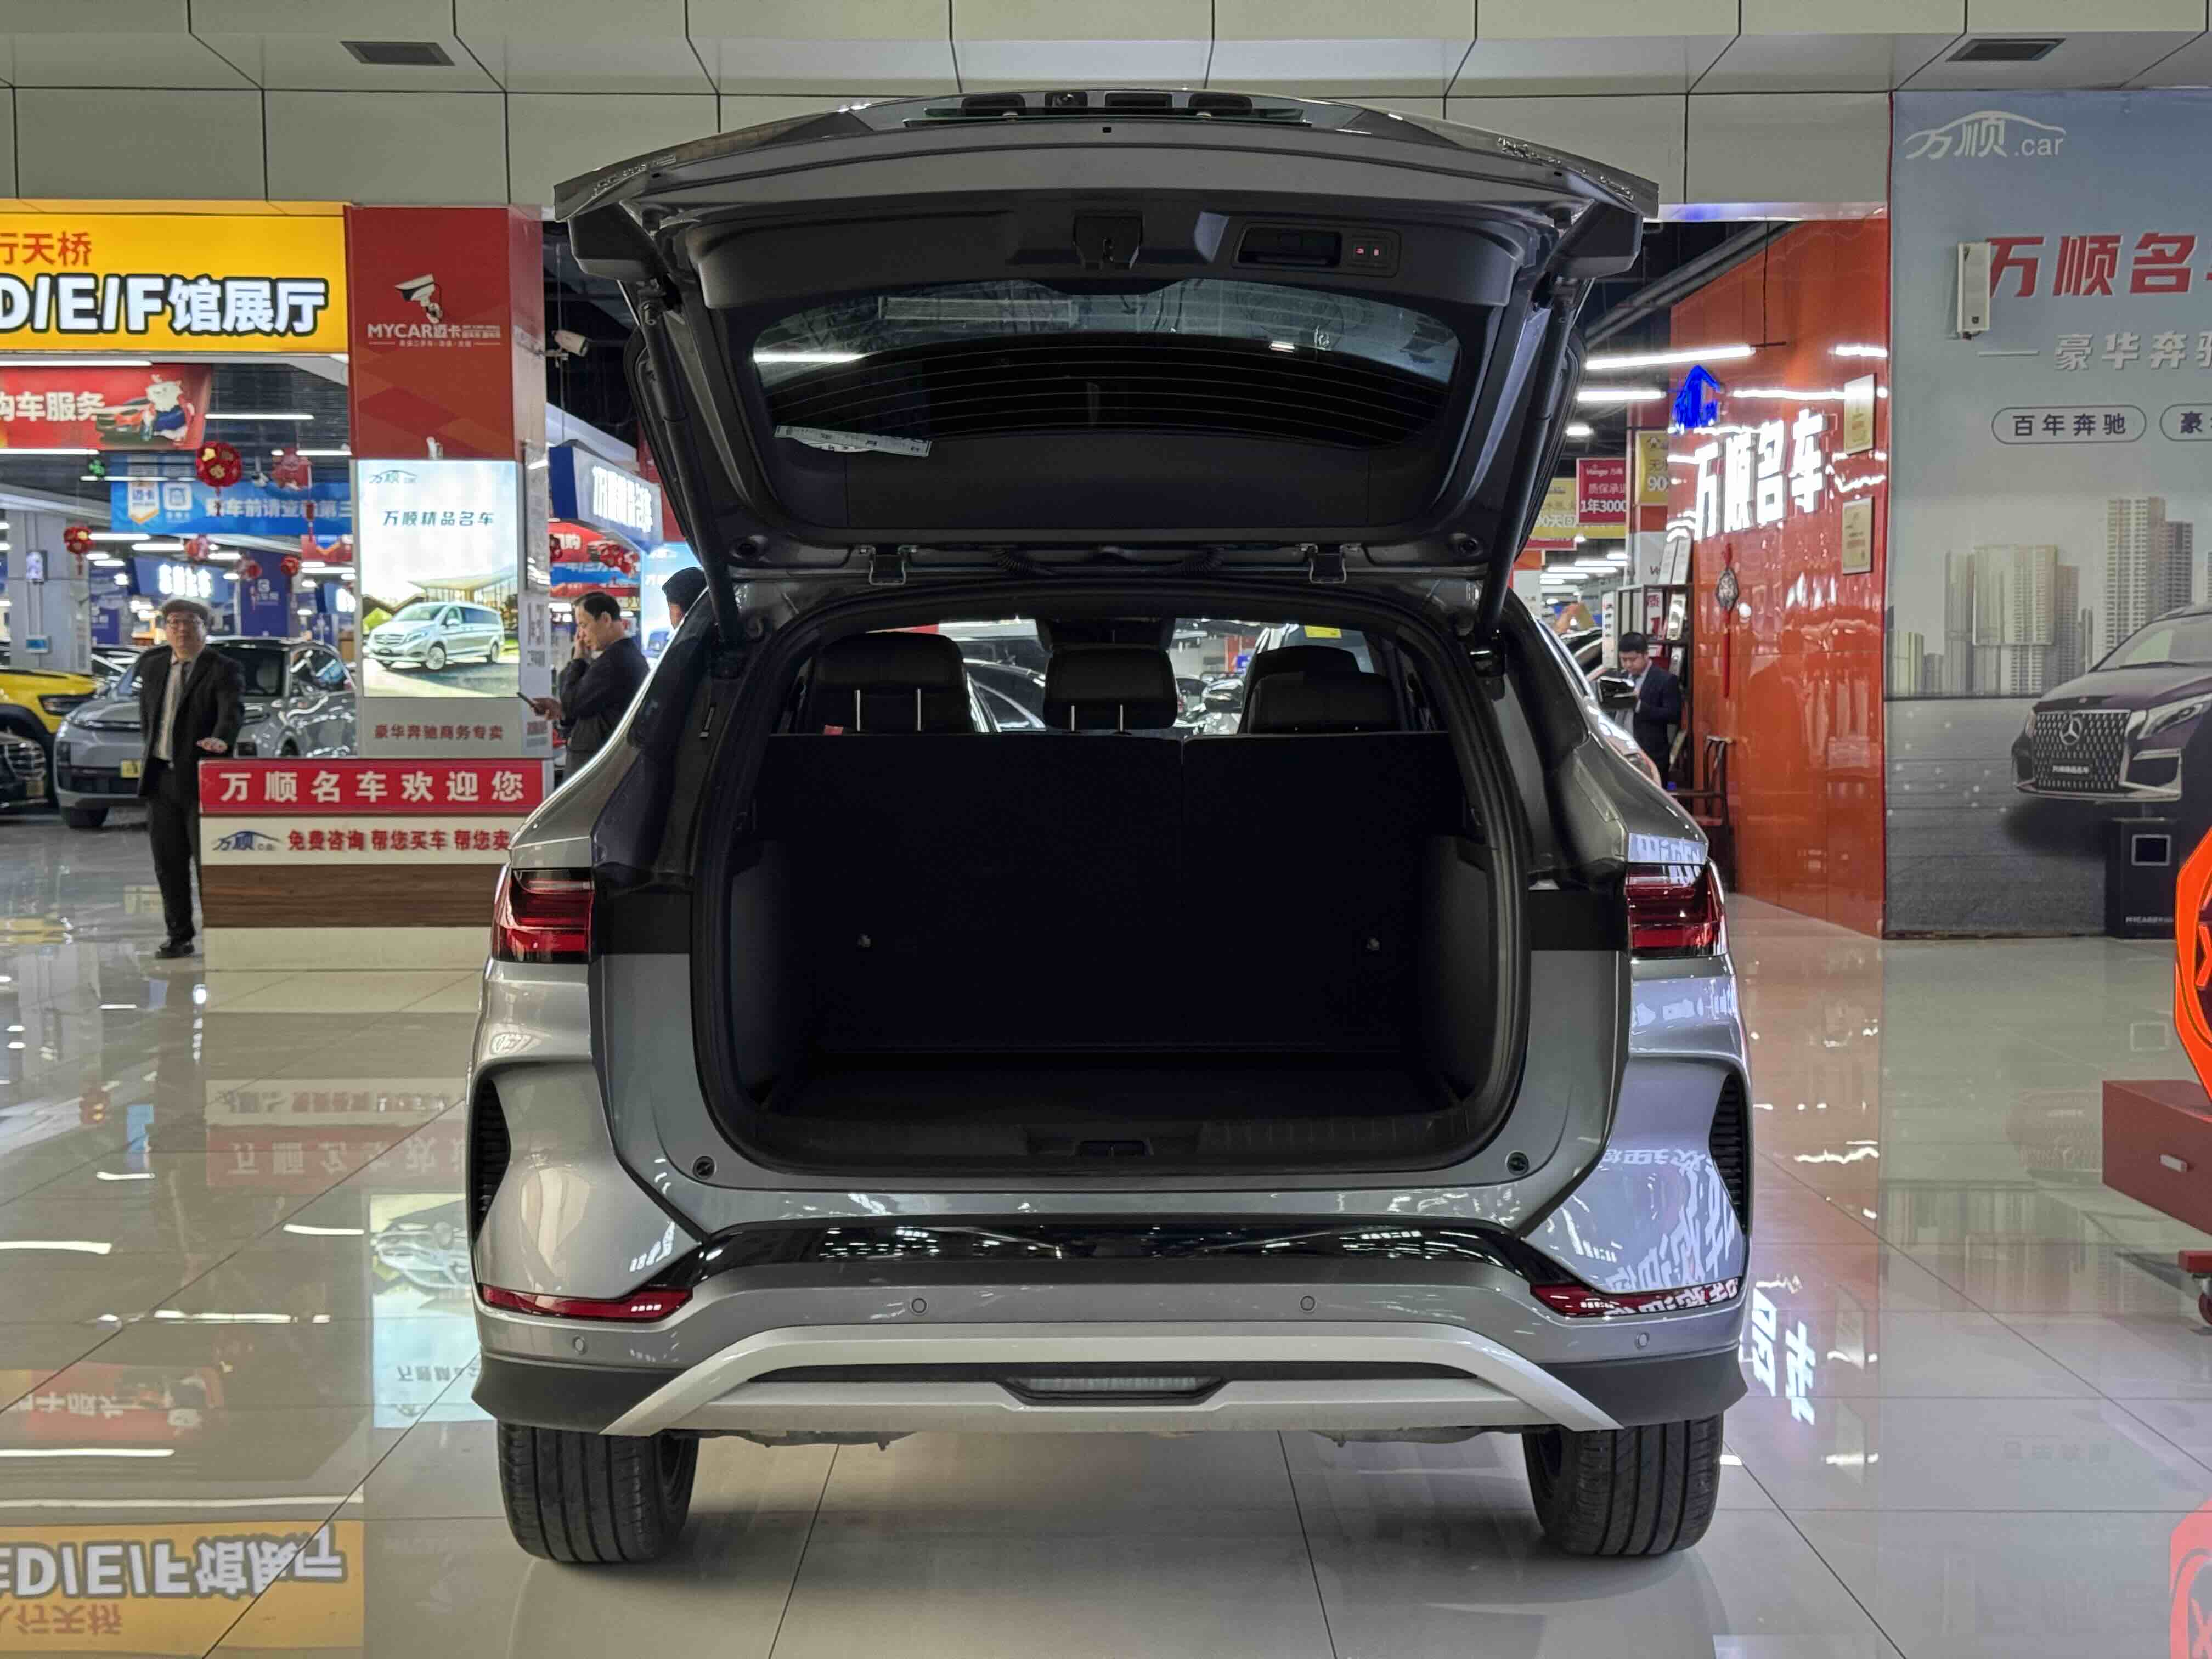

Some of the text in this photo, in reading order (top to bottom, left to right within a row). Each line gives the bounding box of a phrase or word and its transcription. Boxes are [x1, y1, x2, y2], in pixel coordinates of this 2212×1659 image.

[1985, 232, 2212, 298] 万顺名
[2013, 414, 2126, 437] 百年奔驰
[2180, 411, 2212, 433] 豪
[383, 510, 495, 526] 万顺精品名车
[220, 770, 524, 803] 万顺名车欢迎您
[288, 830, 364, 851] 免费咨询
[371, 830, 447, 850] 帮您买车
